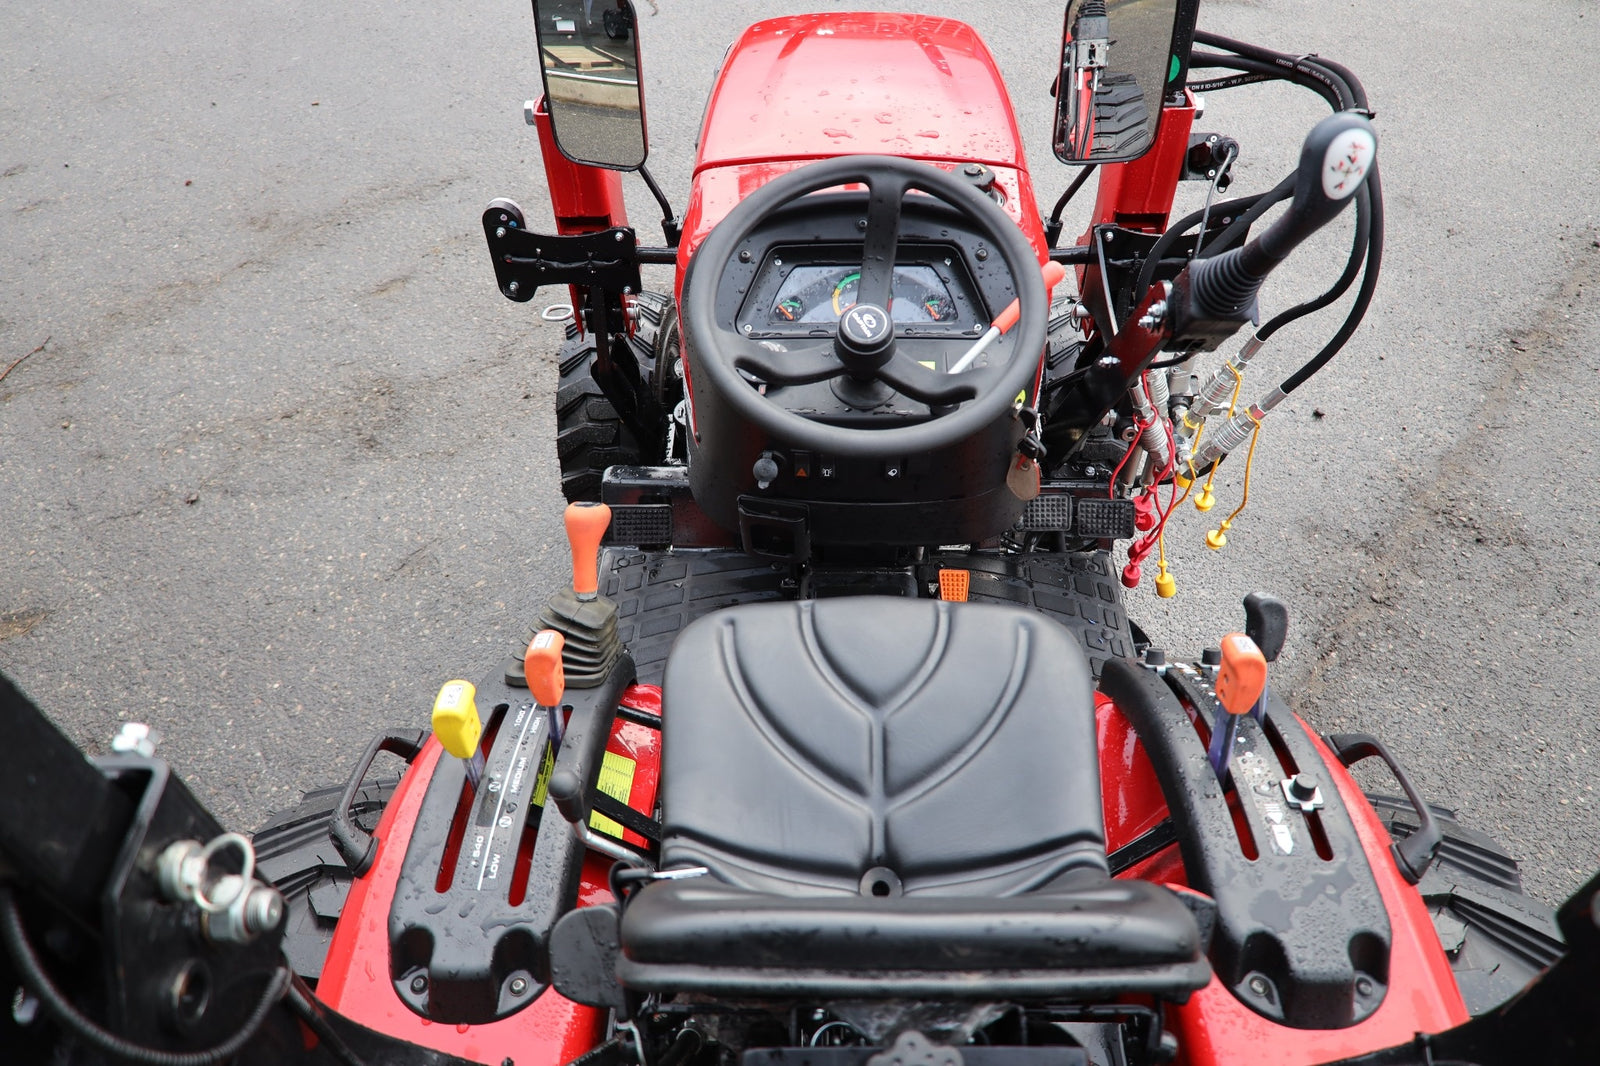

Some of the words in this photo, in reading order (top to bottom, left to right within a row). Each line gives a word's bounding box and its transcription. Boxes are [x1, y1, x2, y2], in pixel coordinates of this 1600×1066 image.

[514, 710, 526, 727] 1000
[530, 716, 542, 734] HIGH
[510, 757, 527, 794] MEDIUM
[488, 781, 502, 792] N
[498, 816, 512, 828] N
[473, 834, 484, 858] 540
[489, 854, 501, 880] LOW
